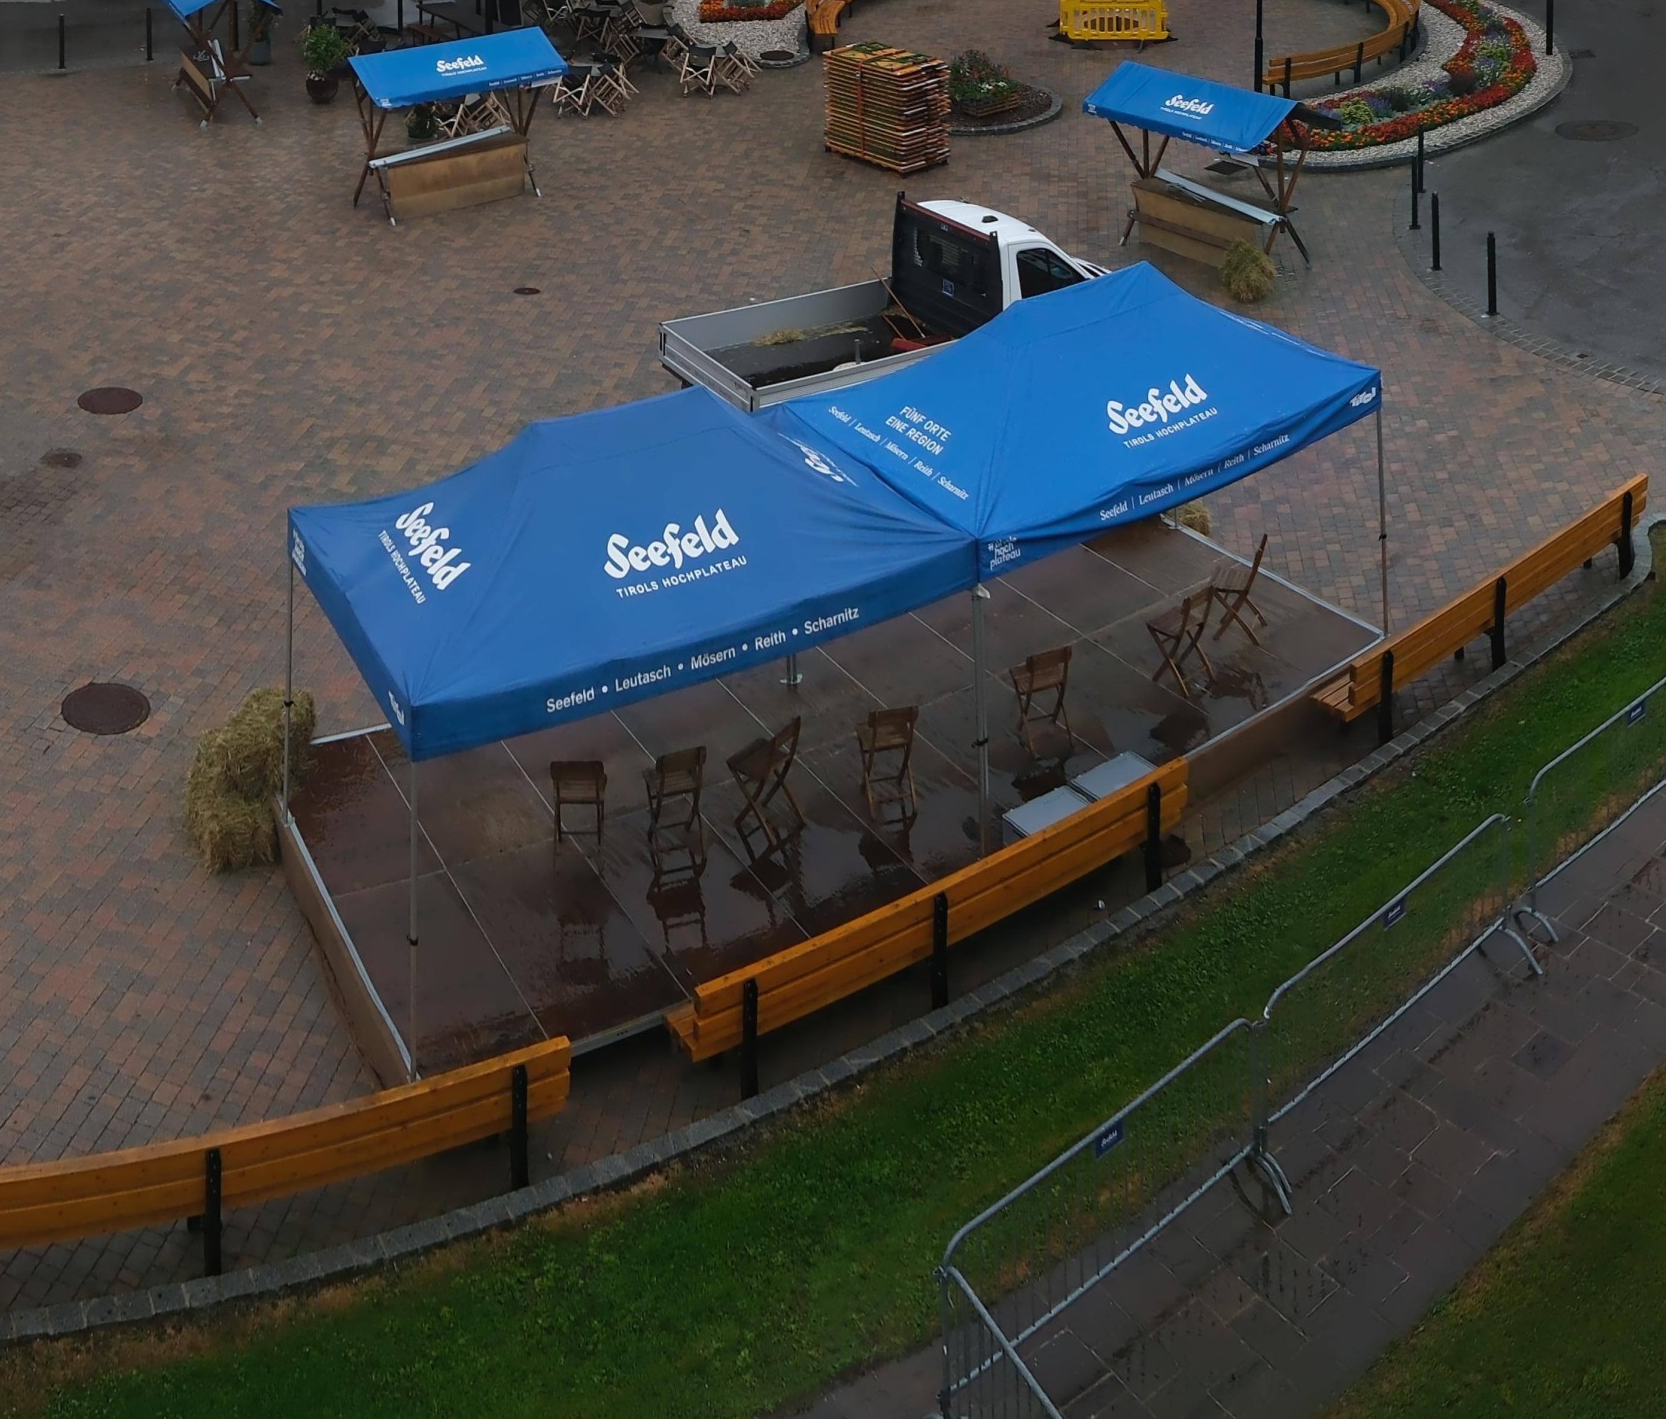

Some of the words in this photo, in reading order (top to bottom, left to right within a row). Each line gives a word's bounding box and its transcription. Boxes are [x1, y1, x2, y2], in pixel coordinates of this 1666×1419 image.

[436, 54, 484, 73] Seefeld
[1165, 94, 1214, 115] Seefeld
[899, 406, 926, 425] FÜNF
[923, 420, 952, 442] ORTE
[1106, 373, 1208, 435] Seefeld
[1123, 432, 1154, 449] TIROLS
[1155, 407, 1218, 439] HOCHPLATEAU
[885, 415, 907, 434] EINE
[905, 427, 945, 456] REGION
[1099, 500, 1129, 522] Seefeld
[1138, 483, 1174, 506] Leutasch
[1223, 453, 1245, 470] Reith
[1253, 434, 1290, 456] Scharnitz
[378, 529, 396, 555] TIROLS
[392, 548, 426, 606] HOCHPLATEAU
[395, 501, 472, 592] Seefeld
[603, 508, 740, 580] Seefeld
[616, 580, 659, 599] TIROLS
[662, 555, 748, 589] HOCHPLATEAU
[546, 688, 595, 713] Seefeld
[615, 665, 672, 692] Leutasch
[691, 645, 736, 671] Mösern
[755, 630, 786, 651] Reith
[804, 607, 860, 635] Scharnitz
